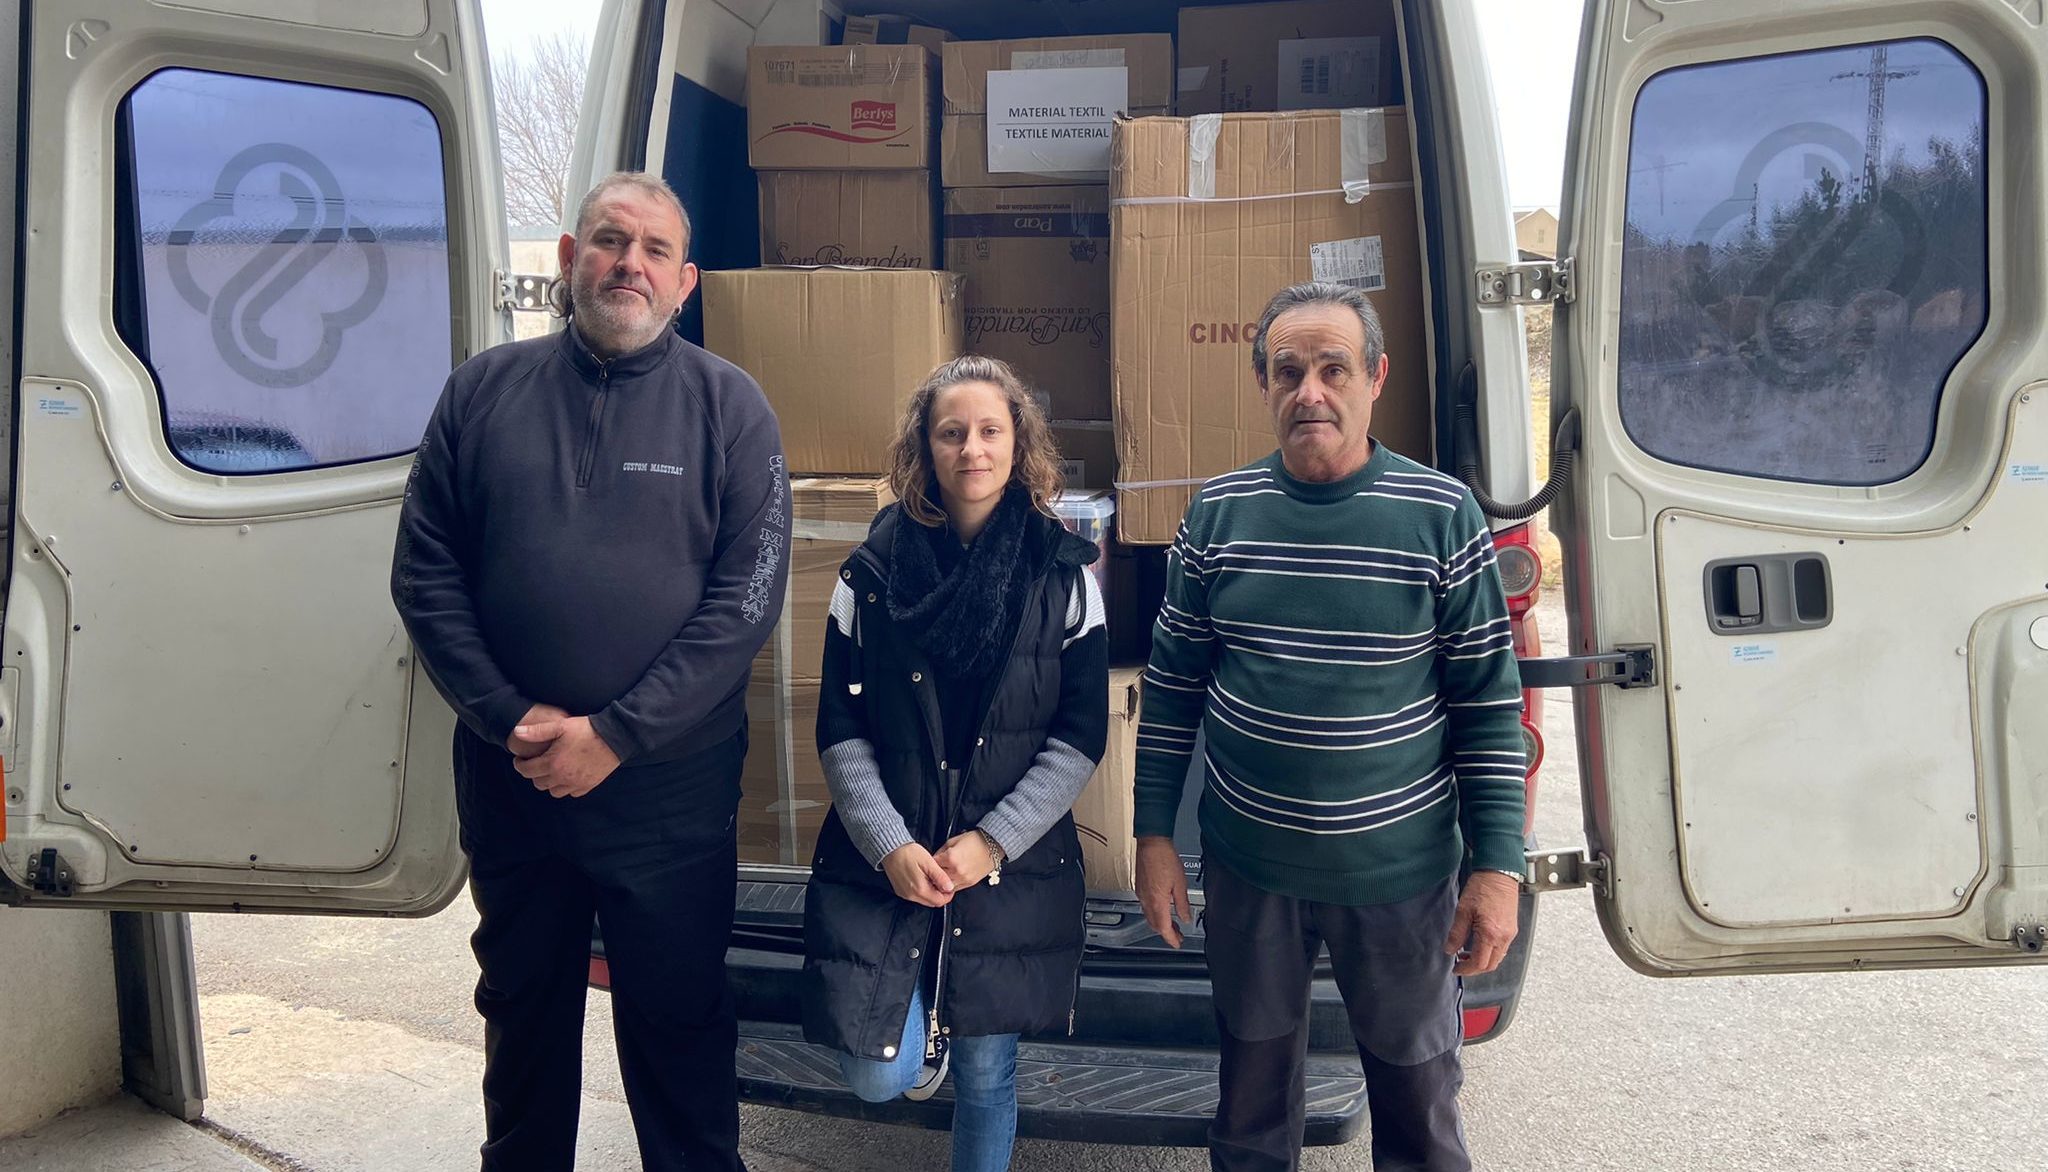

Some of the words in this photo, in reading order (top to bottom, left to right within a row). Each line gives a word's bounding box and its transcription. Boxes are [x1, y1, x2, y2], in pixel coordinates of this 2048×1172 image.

[764, 60, 796, 71] 107671
[853, 106, 895, 126] Berlys
[1008, 107, 1066, 118] MATERIAL
[1069, 106, 1106, 117] TEXTIL
[1005, 128, 1048, 139] TEXTILE
[1051, 127, 1109, 139] MATERIAL
[1014, 216, 1052, 232] Pan
[1078, 307, 1090, 315] LO
[623, 462, 648, 472] CUSTOM
[650, 463, 684, 475] MAESTRAT
